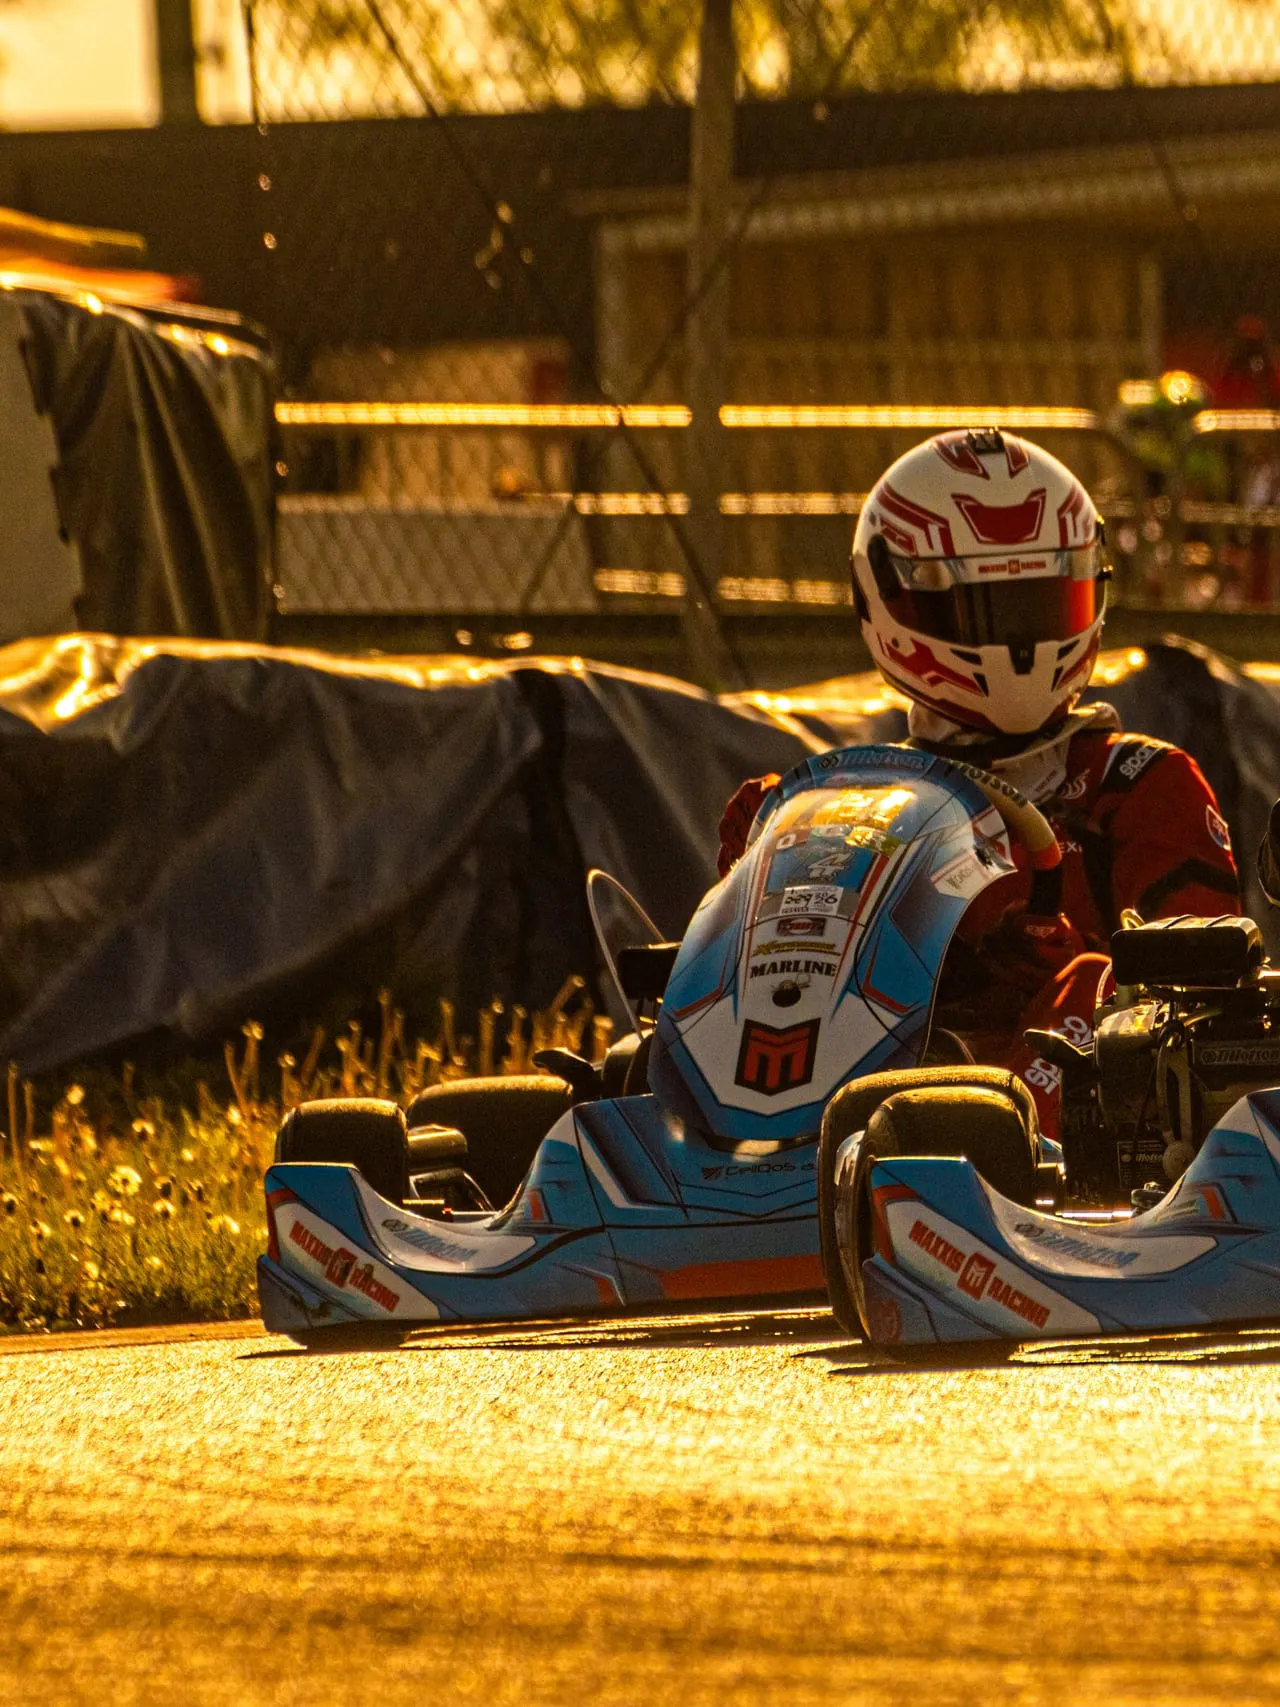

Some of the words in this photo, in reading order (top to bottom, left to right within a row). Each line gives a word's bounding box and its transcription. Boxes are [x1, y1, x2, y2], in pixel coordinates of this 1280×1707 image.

[750, 960, 838, 979] MARLINE
[289, 1220, 336, 1267] MAXXIS
[349, 1267, 400, 1313] RACING
[908, 1220, 966, 1273] MAXXIS
[987, 1276, 1051, 1330] RACING
